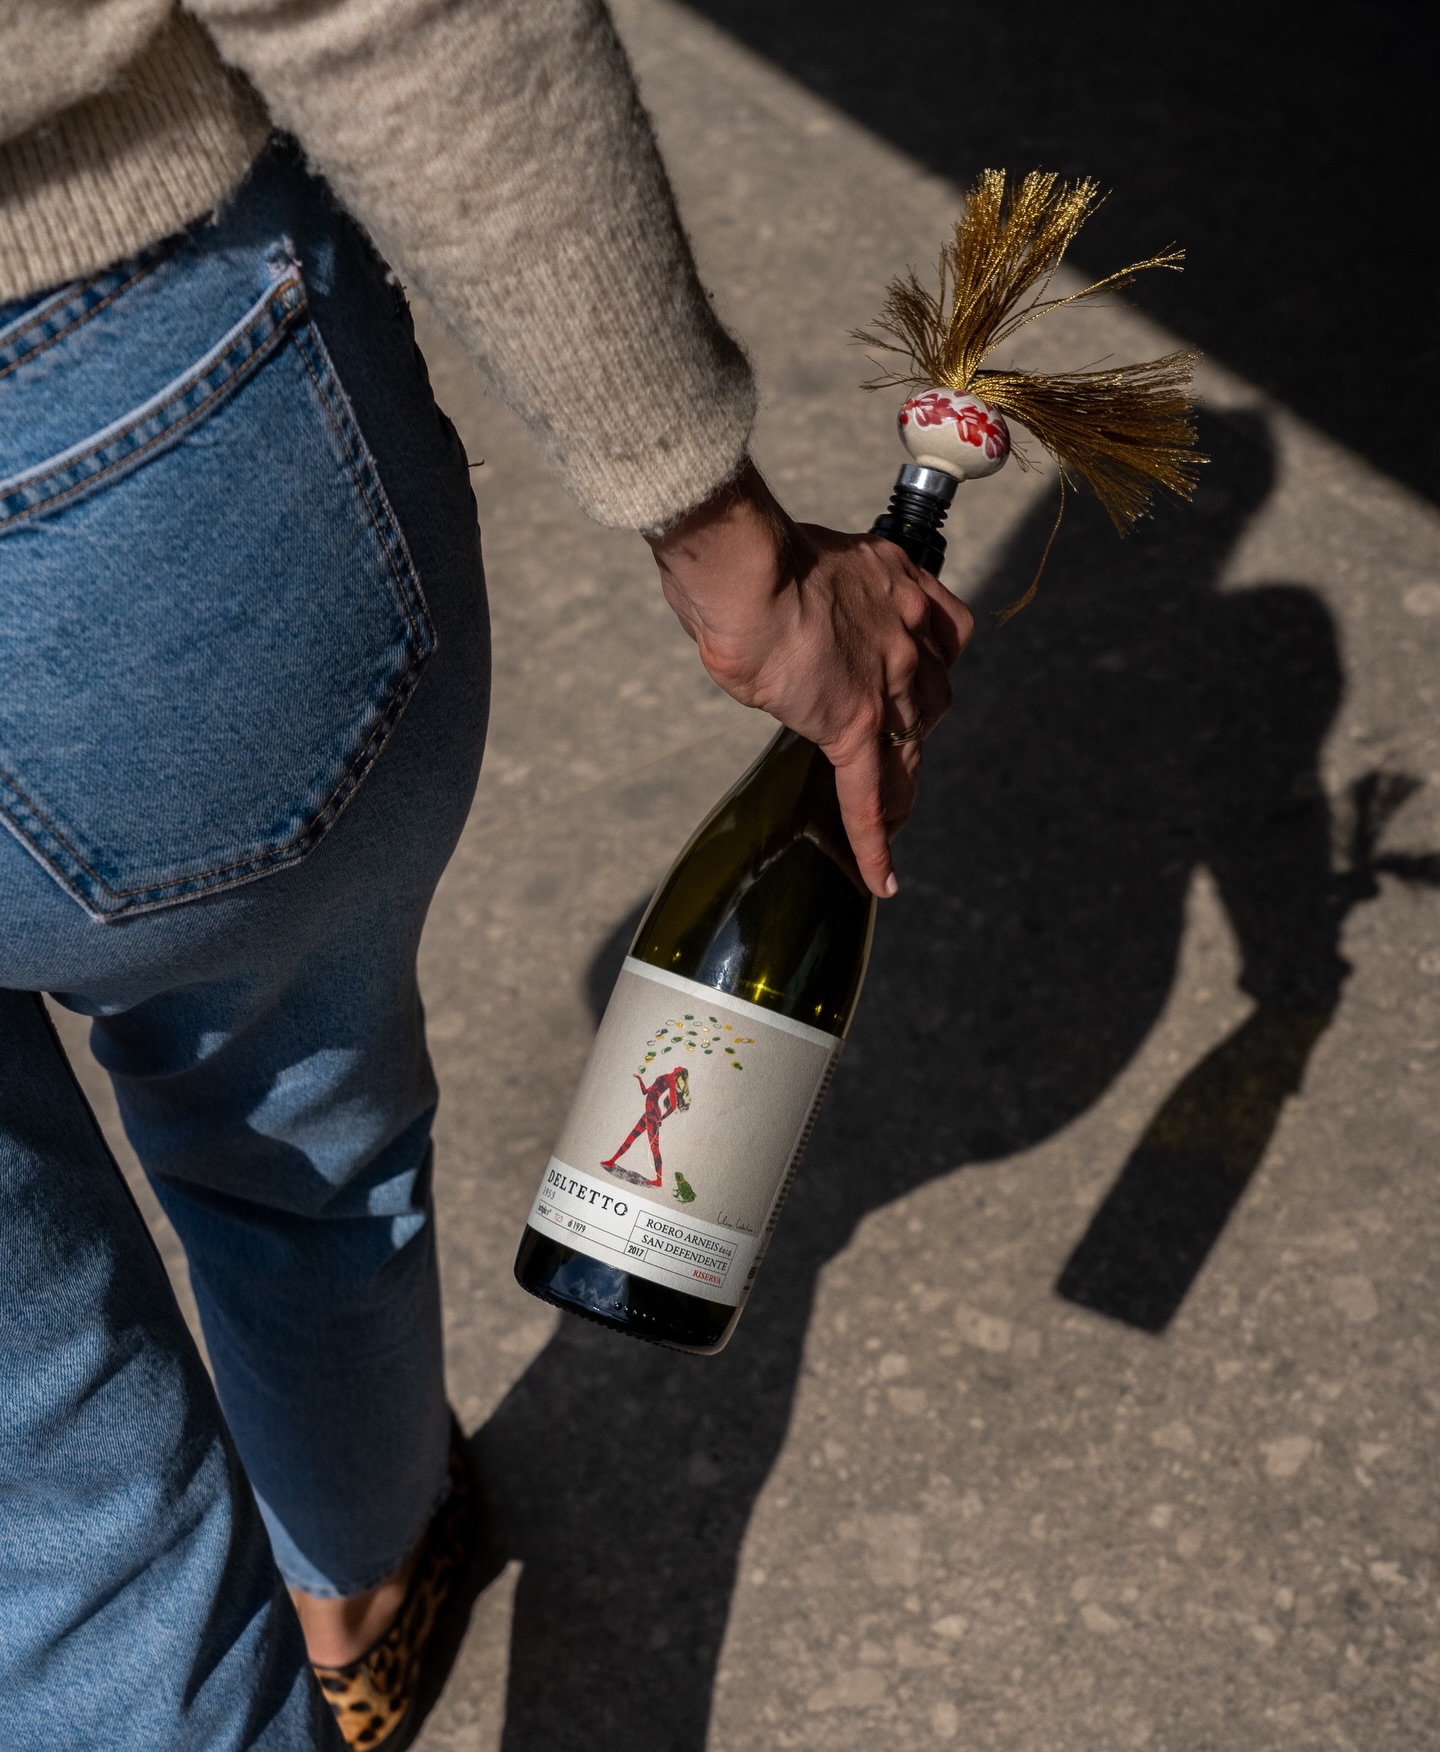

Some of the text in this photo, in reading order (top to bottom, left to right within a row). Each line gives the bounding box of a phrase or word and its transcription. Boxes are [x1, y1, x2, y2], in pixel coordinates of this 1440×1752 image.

[542, 1186, 556, 1200] 1953
[548, 1169, 629, 1217] DELTETTO
[573, 1221, 587, 1233] 1979
[646, 1218, 684, 1239] ROERO
[684, 1233, 720, 1252] ARNEIS
[629, 1245, 645, 1257] 2017
[641, 1234, 728, 1272] SAN DEFENDENTE
[692, 1269, 722, 1285] RISERVA
